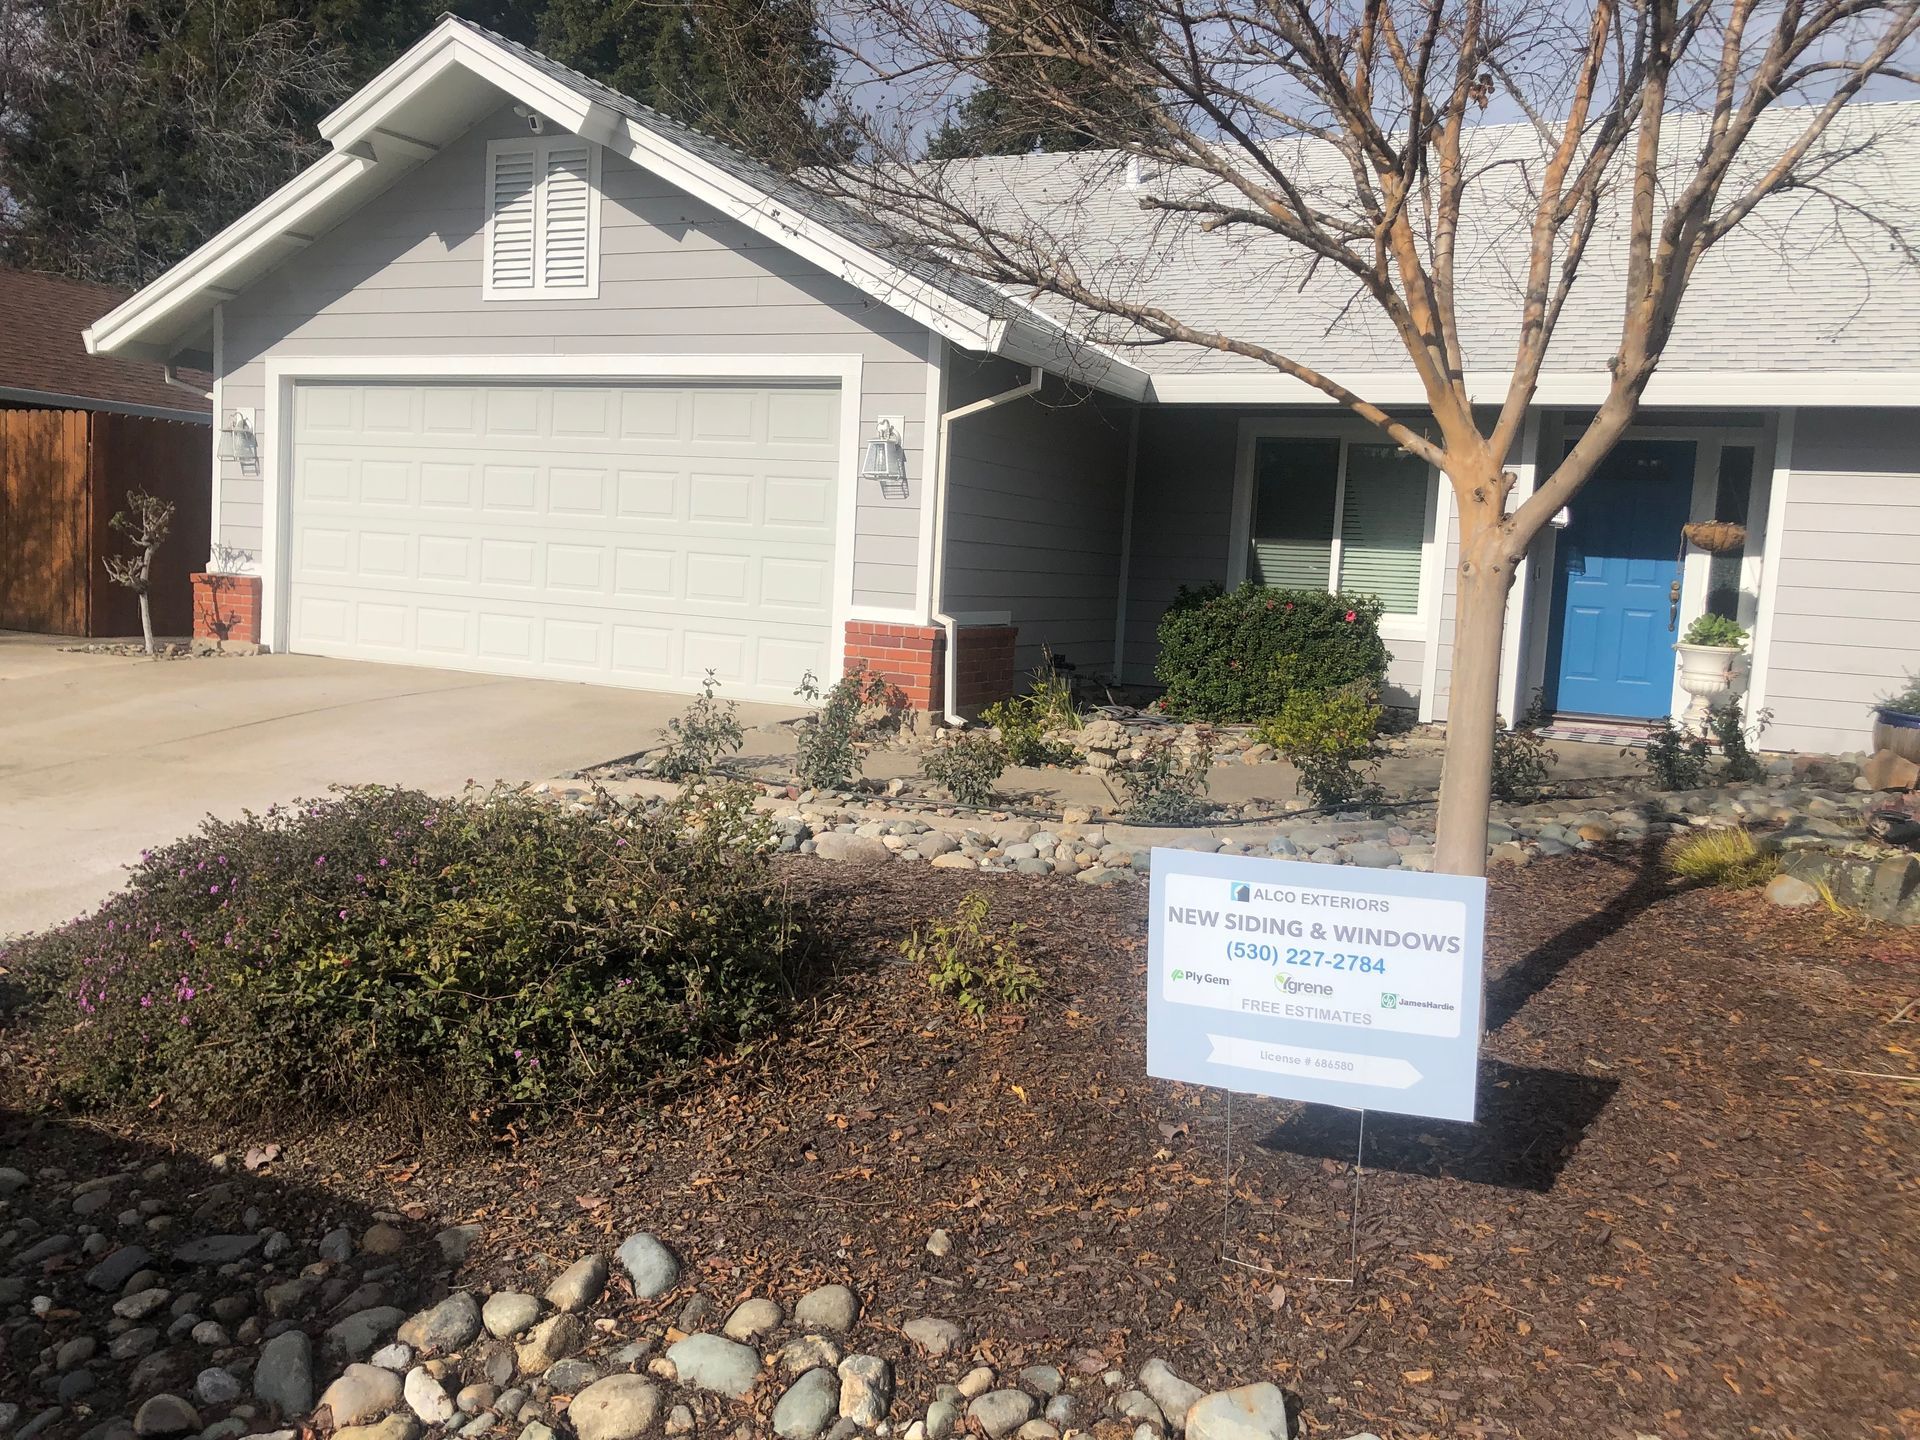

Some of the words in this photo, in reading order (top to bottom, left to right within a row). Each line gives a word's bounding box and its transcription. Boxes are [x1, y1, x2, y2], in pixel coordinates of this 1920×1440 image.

[1253, 888, 1296, 903] ALCO
[1301, 893, 1390, 913] EXTERIORS
[1168, 906, 1219, 927] NEW
[1224, 912, 1303, 938] SIDING
[1310, 922, 1327, 941] &
[1333, 924, 1461, 954] WINDOWS
[1226, 940, 1278, 966] (530)
[1286, 947, 1386, 974] 227-2784
[1185, 970, 1203, 985] Ply
[1204, 973, 1230, 986] Gem
[1278, 975, 1333, 995] Ygrene
[1241, 998, 1280, 1015] FREE
[1285, 1004, 1373, 1026] ESTIMATES
[1398, 997, 1455, 1011] JamesHardie
[1260, 1050, 1301, 1066] License
[1304, 1057, 1312, 1066] #
[1314, 1058, 1354, 1072] 686580
